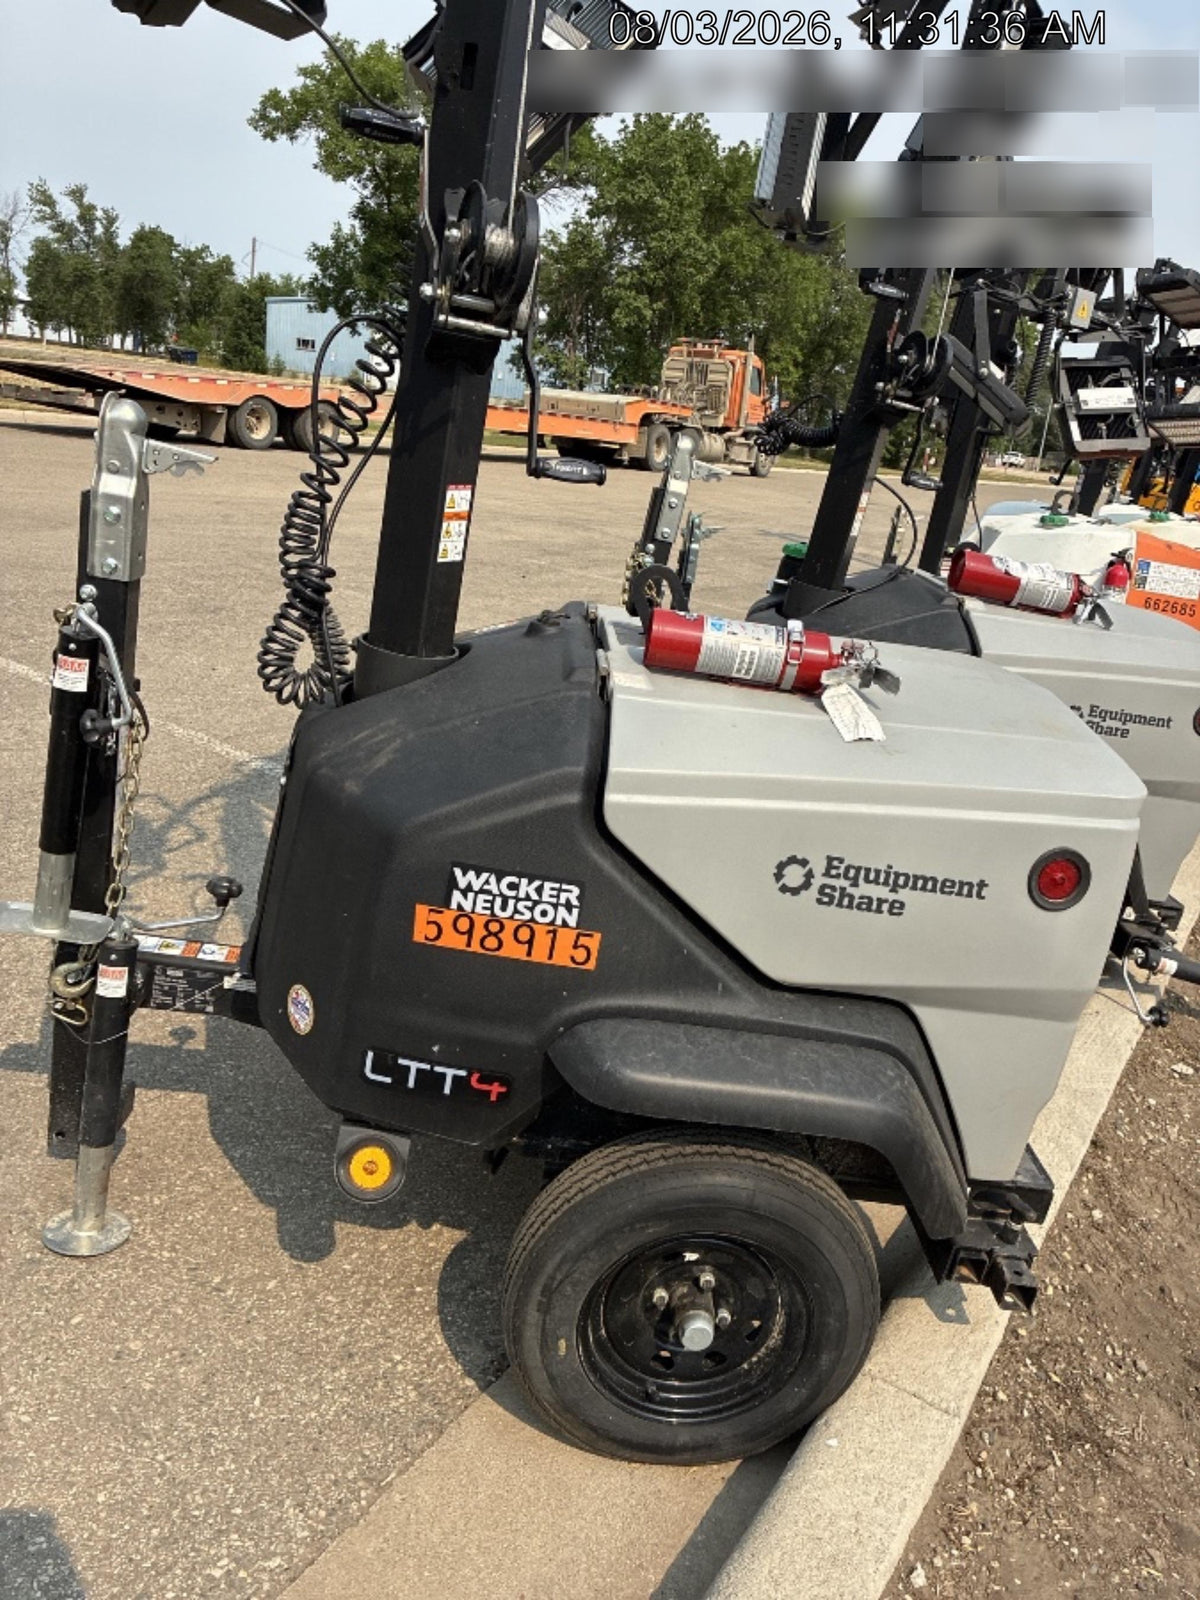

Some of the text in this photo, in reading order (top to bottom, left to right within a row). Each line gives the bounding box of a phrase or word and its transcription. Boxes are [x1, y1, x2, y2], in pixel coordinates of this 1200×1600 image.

[1144, 597, 1197, 618] 662685
[1087, 704, 1173, 729] Equipment
[452, 866, 581, 906] WACKER
[821, 855, 989, 900] Equipment
[450, 890, 580, 927] NEUSON
[816, 883, 906, 916] Share
[424, 908, 595, 966] 598915
[363, 1050, 508, 1102] LTT4
